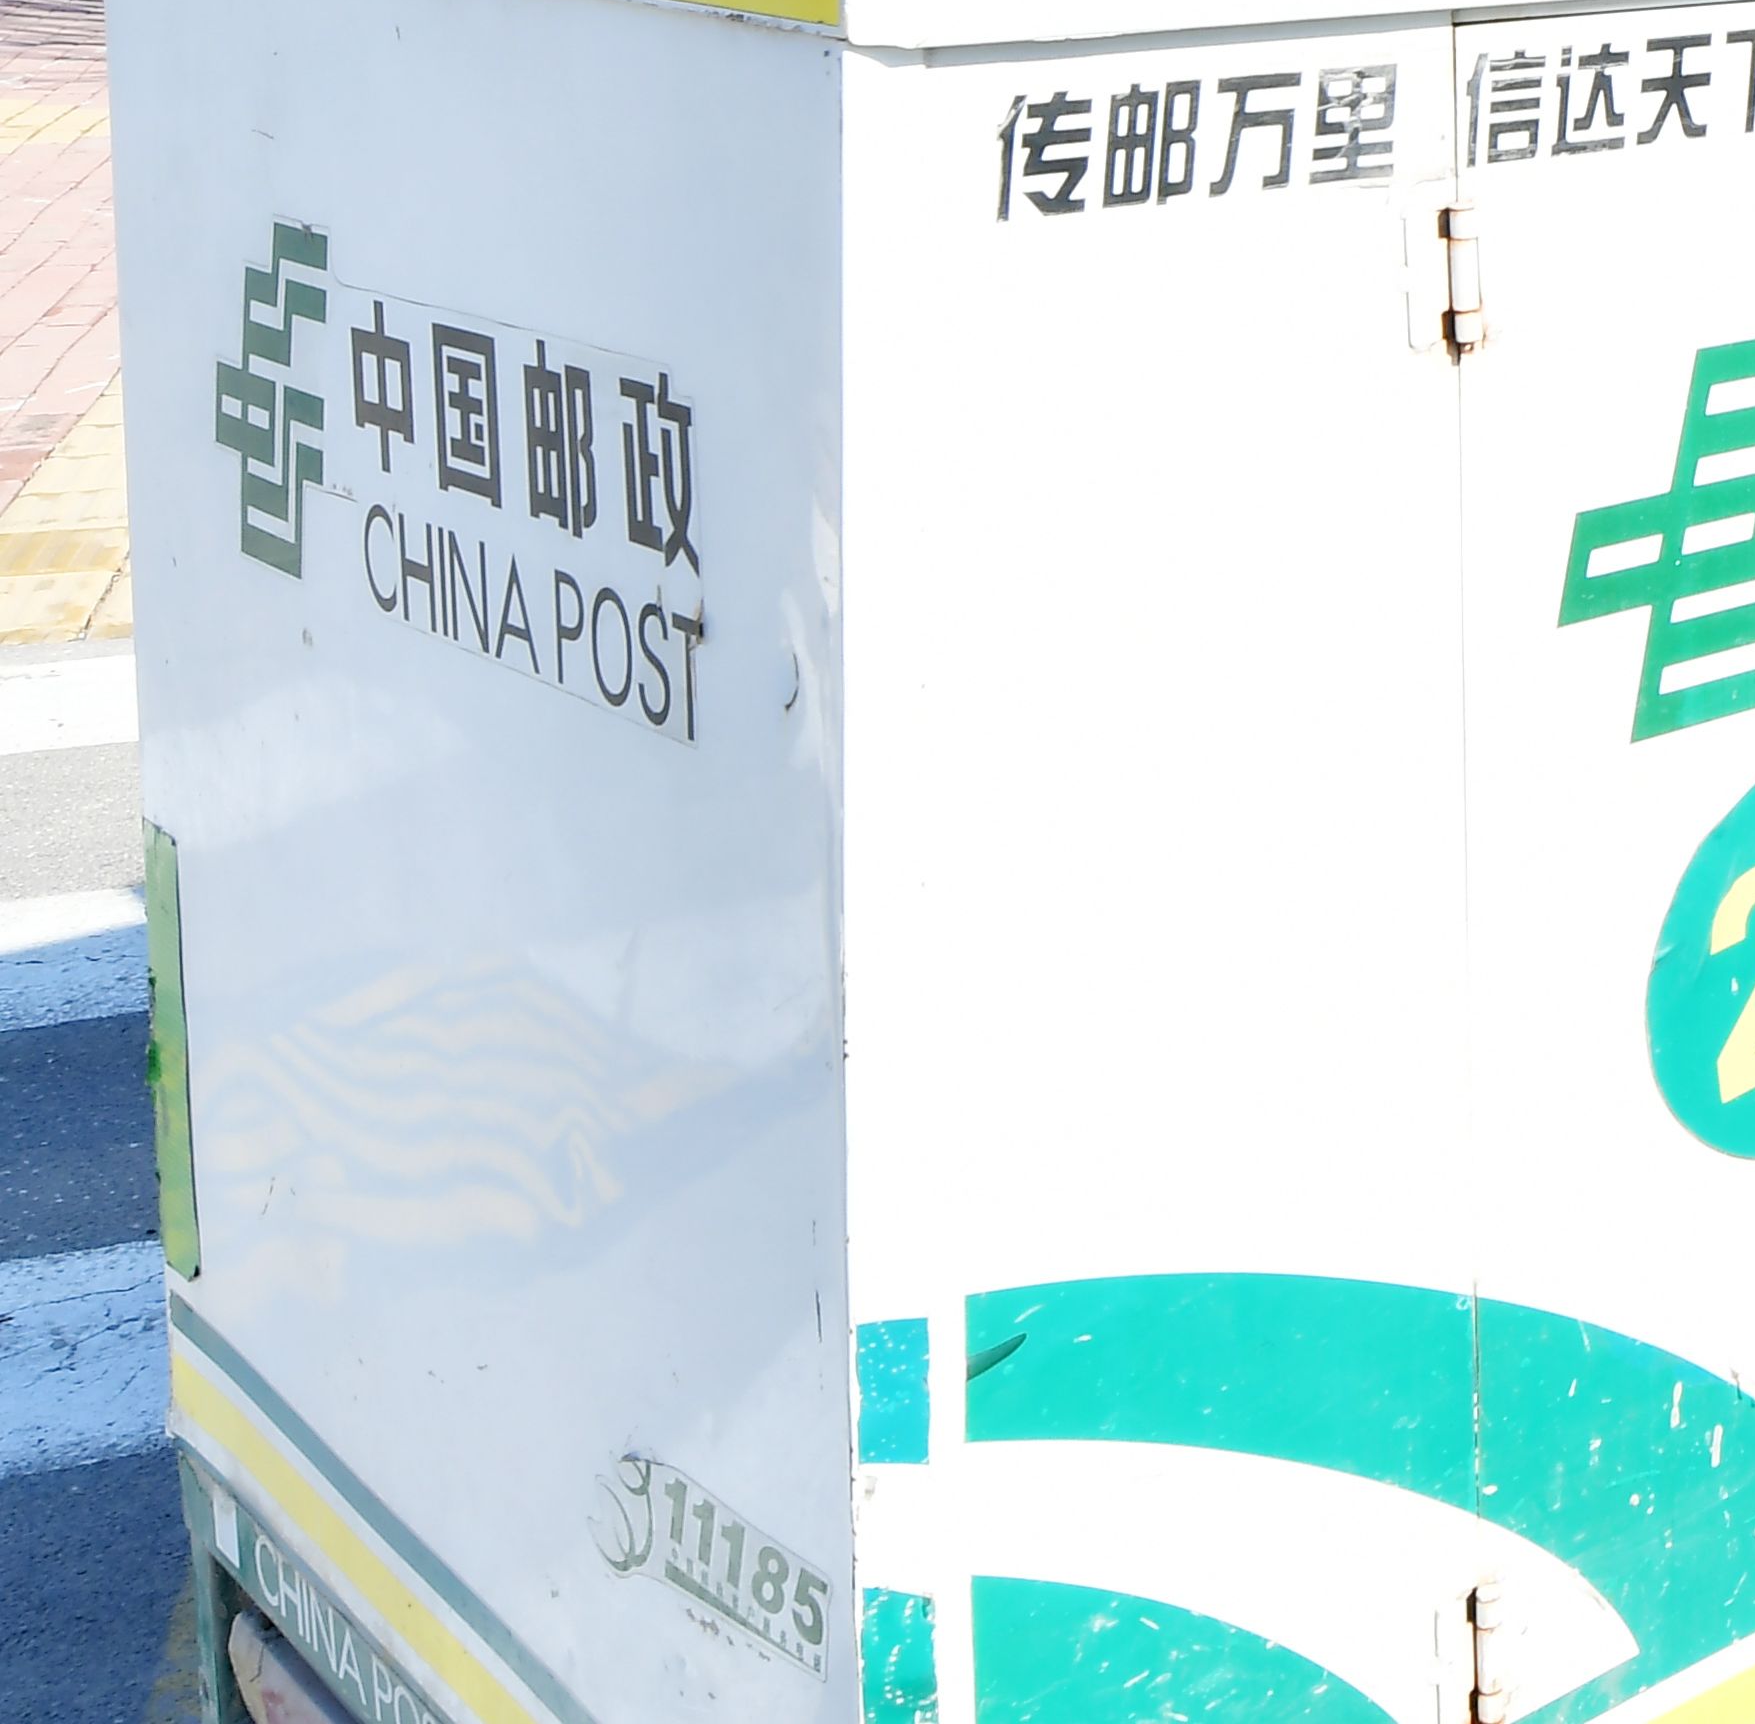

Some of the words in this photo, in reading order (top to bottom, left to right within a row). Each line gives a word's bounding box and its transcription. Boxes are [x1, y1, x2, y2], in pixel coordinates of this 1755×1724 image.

[996, 63, 1399, 223] 传邮万里
[350, 299, 702, 577] 中国邮政
[363, 503, 541, 675] CHINA
[554, 568, 703, 742] POST
[253, 1533, 368, 1708] CHINA
[663, 1476, 830, 1648] 11185
